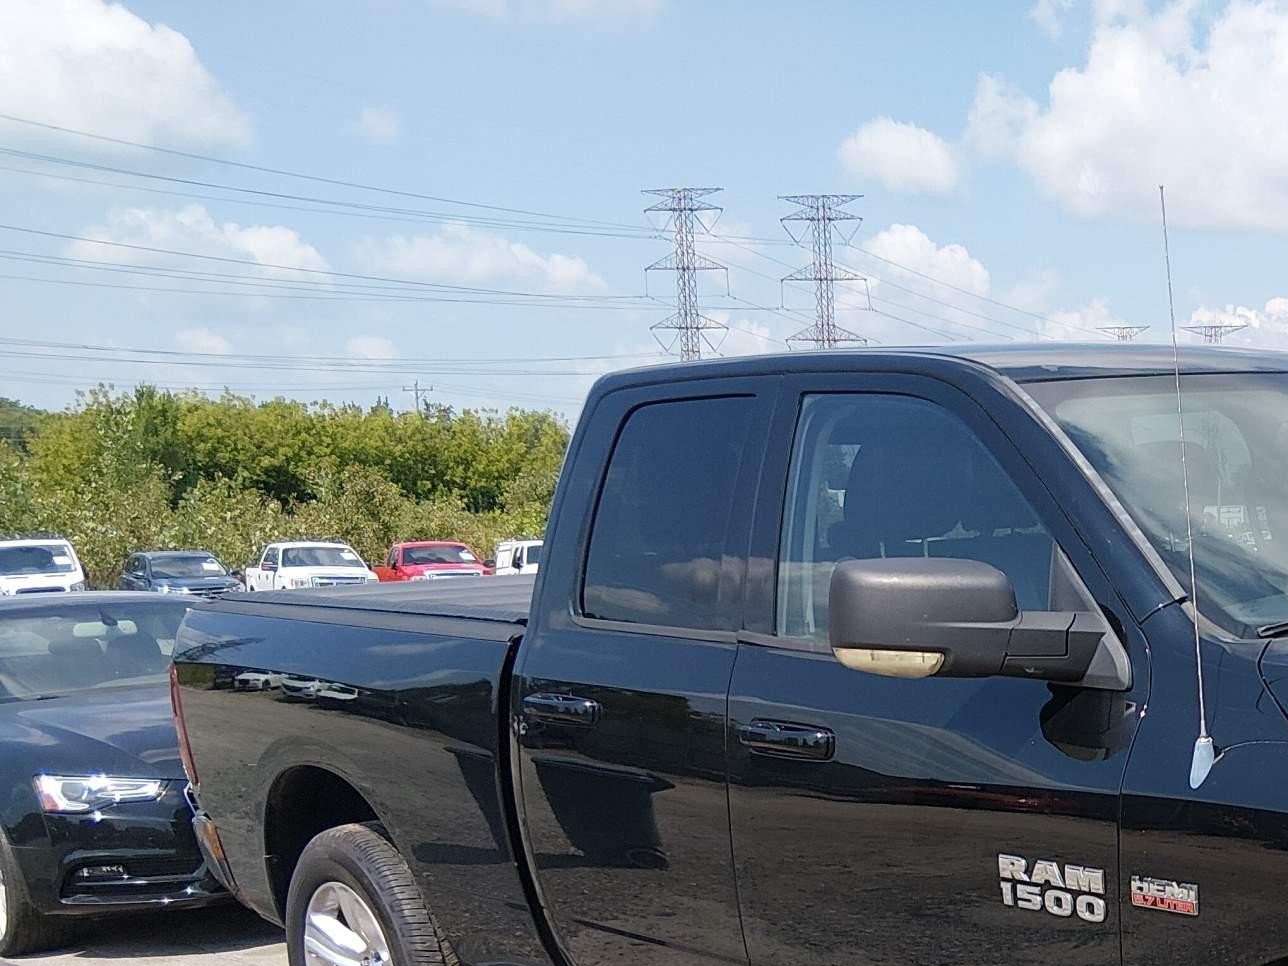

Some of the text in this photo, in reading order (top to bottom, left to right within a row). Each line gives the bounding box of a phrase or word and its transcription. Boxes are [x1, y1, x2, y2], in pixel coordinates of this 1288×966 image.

[997, 852, 1106, 895] RAM
[1130, 874, 1199, 902] HEMI
[999, 880, 1107, 923] 1500
